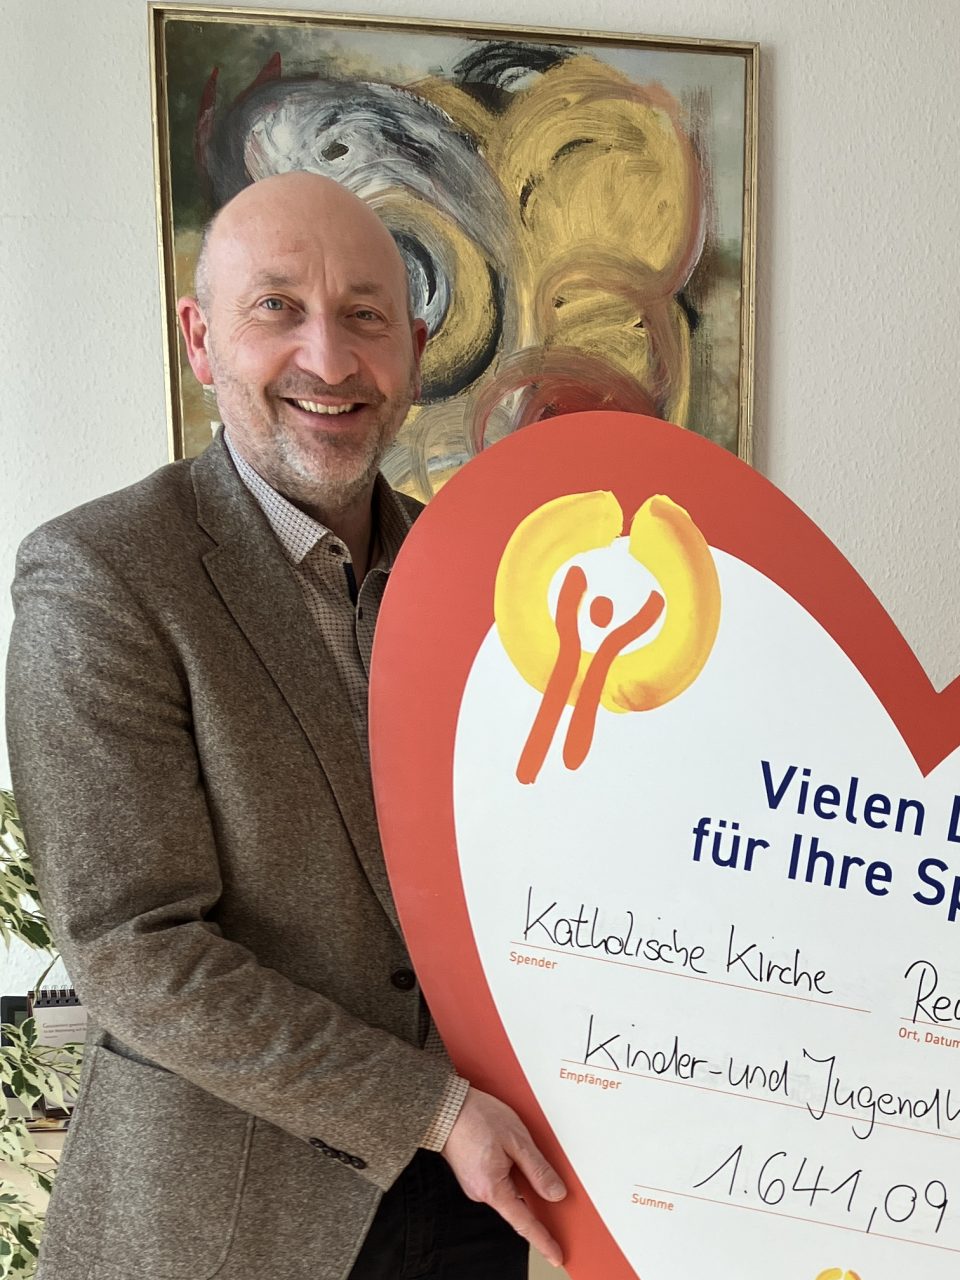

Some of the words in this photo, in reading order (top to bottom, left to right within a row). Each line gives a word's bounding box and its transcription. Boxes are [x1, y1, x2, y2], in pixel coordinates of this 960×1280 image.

[760, 759, 926, 836] Vielen
[692, 817, 771, 872] für
[787, 833, 893, 897] Ihre
[508, 950, 559, 971] Spender
[523, 886, 708, 975] Katholische
[726, 924, 834, 995] Kirche
[897, 1026, 922, 1045] Ort,
[558, 1067, 622, 1092] Empfänger
[631, 1192, 675, 1212] Summe
[692, 1144, 949, 1233] 1.641,09
